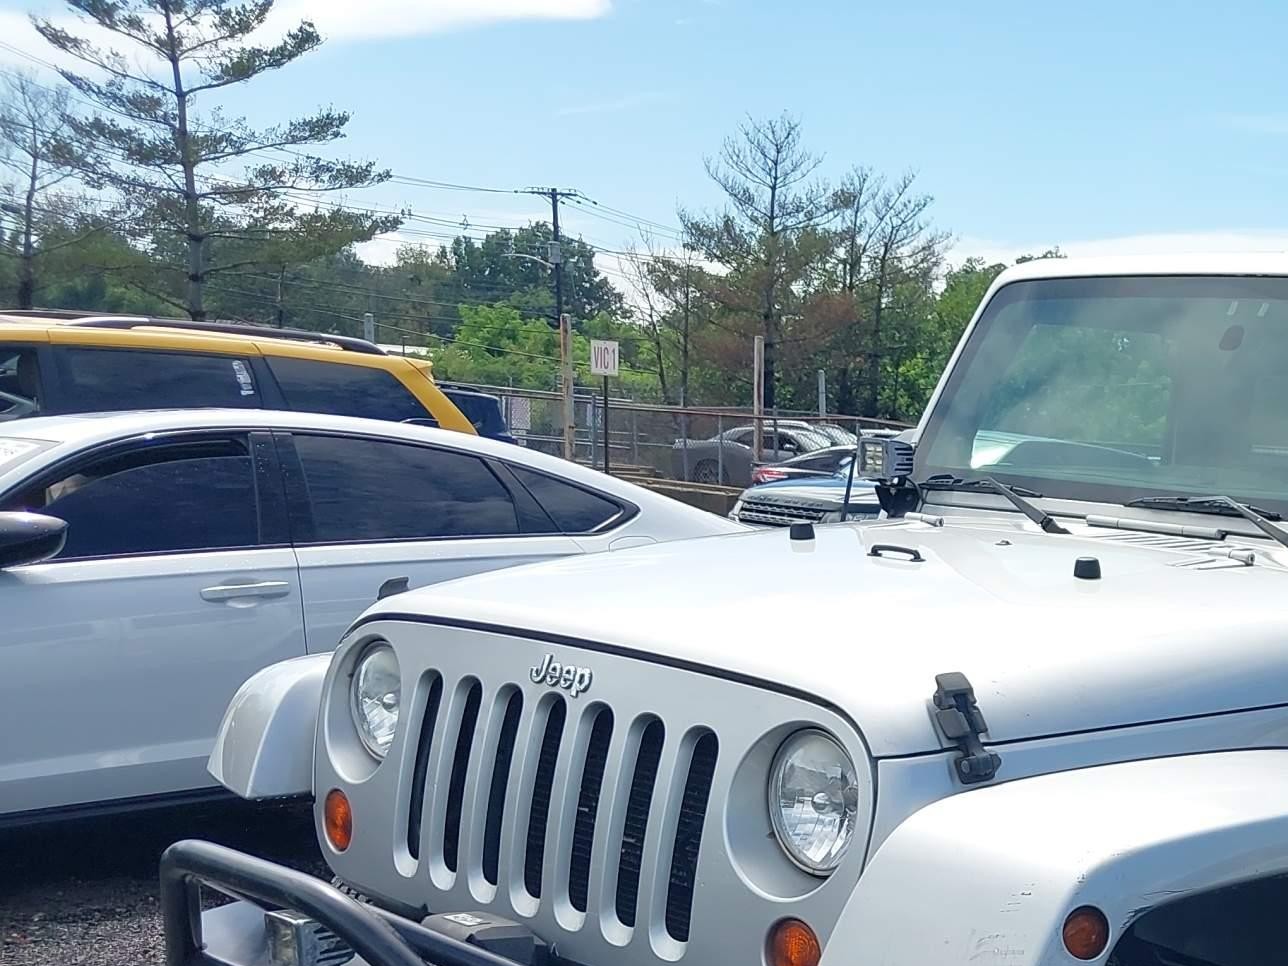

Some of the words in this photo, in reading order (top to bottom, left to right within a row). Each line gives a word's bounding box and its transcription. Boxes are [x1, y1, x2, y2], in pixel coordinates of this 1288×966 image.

[593, 346, 609, 370] VIC
[611, 347, 616, 371] 1
[529, 654, 593, 698] Jeep
